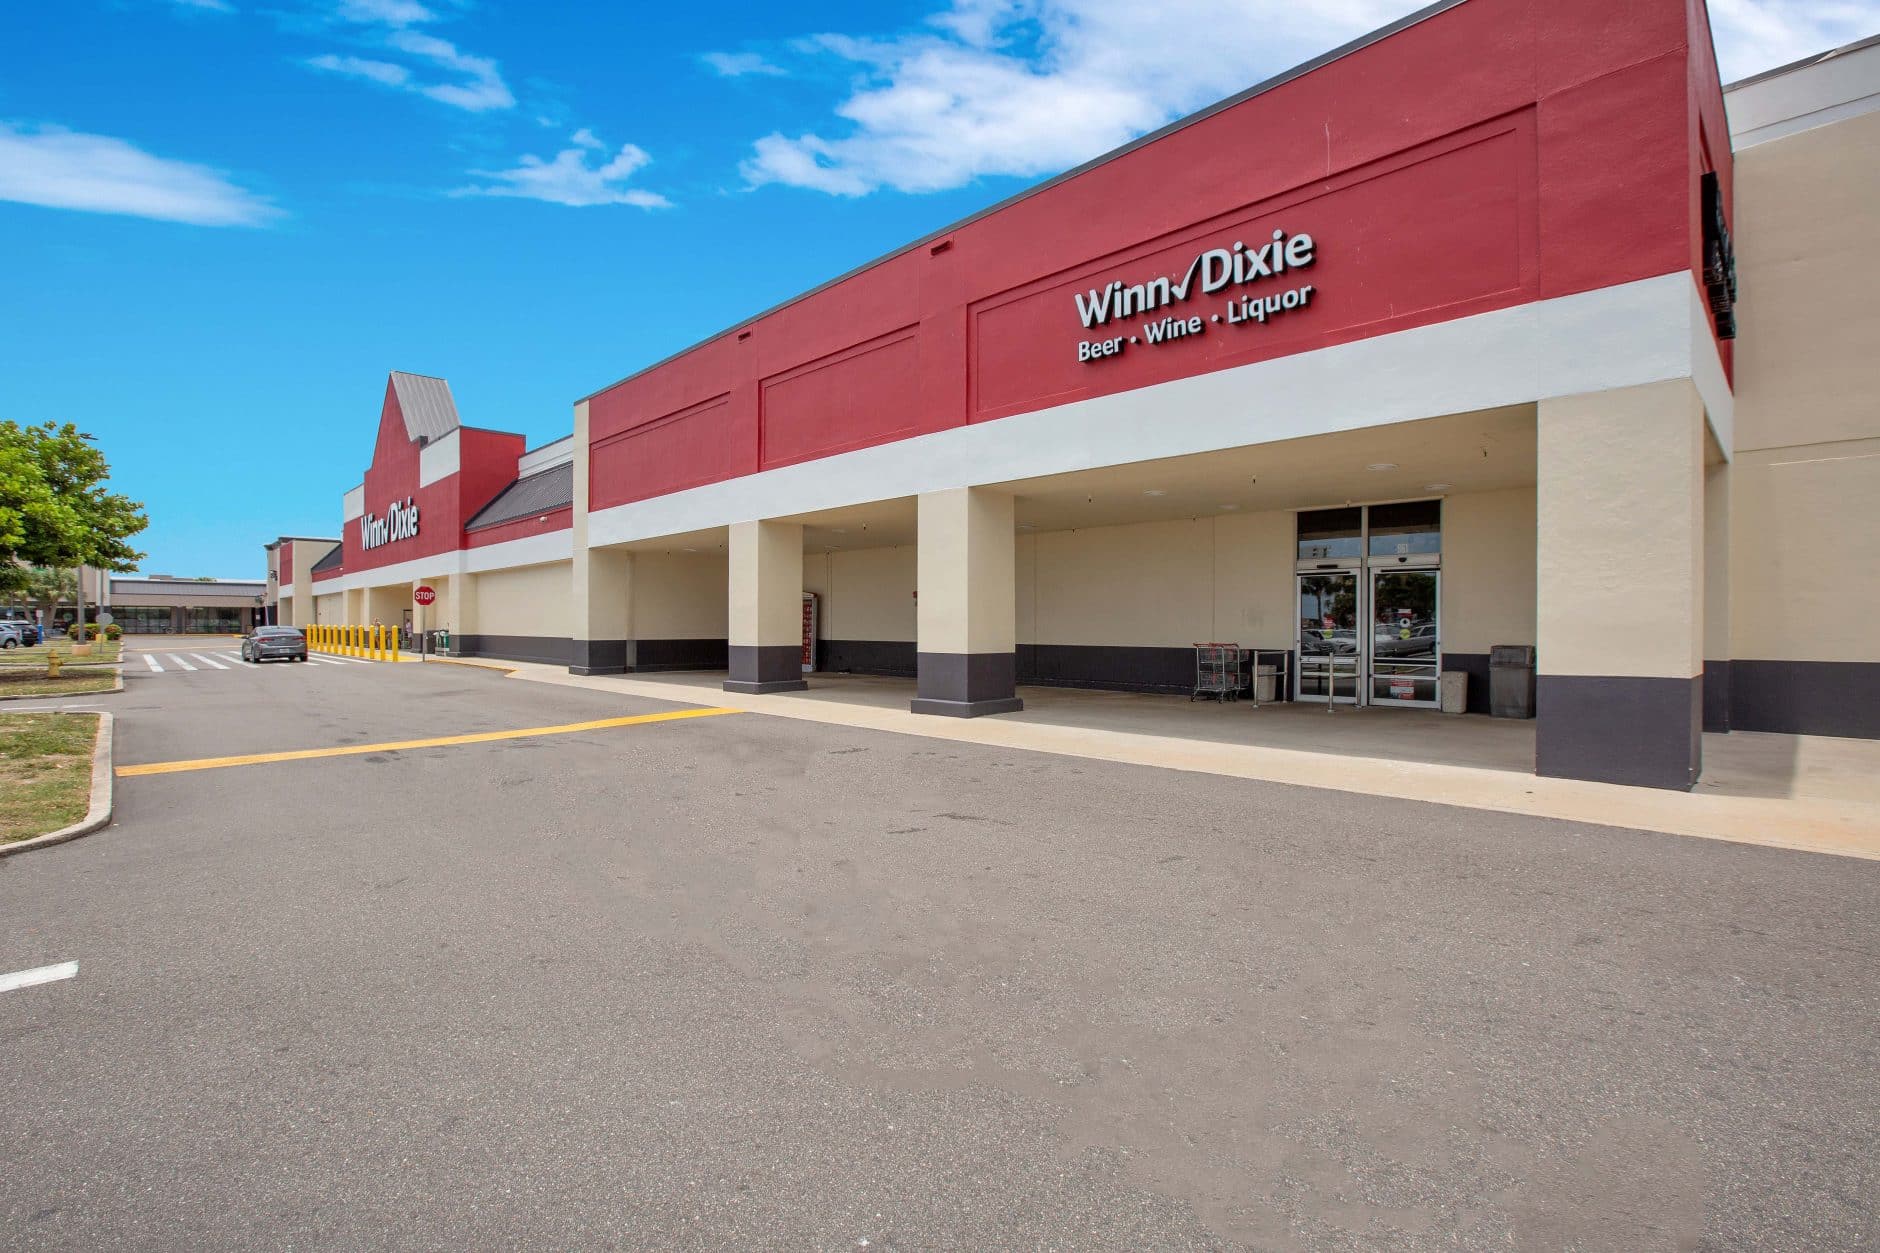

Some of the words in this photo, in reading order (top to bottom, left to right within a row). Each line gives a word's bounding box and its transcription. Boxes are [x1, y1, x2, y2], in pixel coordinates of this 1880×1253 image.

[1075, 281, 1170, 328] Winn
[1202, 229, 1314, 293] Dixie
[1078, 336, 1123, 362] Beer
[1144, 316, 1202, 344] Wine
[1228, 285, 1313, 323] Liquor
[361, 512, 385, 550] Winn
[390, 496, 418, 542] Dixie
[415, 591, 436, 600] STOP
